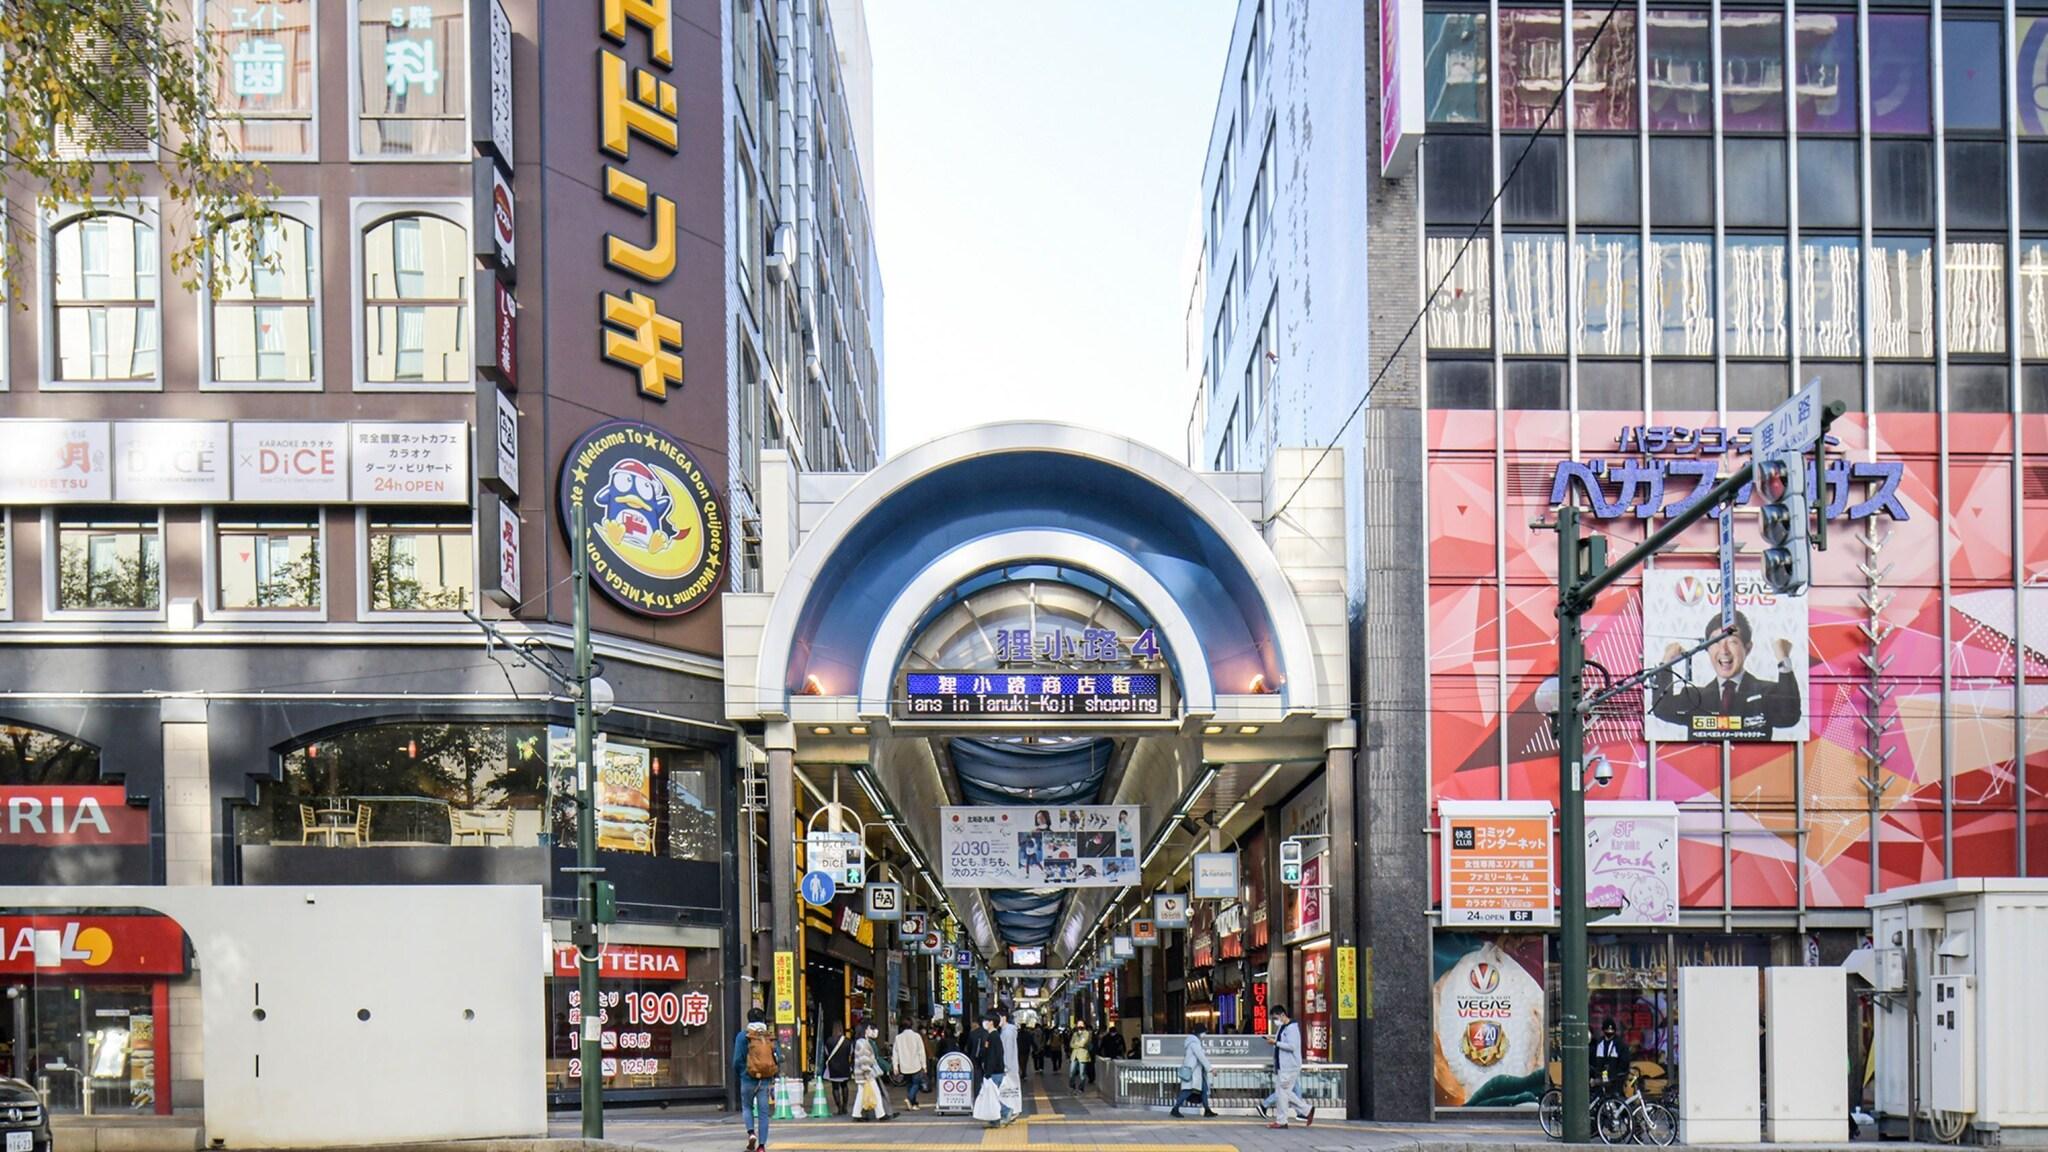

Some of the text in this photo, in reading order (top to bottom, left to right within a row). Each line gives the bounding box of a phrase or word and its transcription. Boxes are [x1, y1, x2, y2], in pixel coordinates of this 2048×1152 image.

[231, 7, 285, 30] エイト
[390, 7, 433, 29] 5階
[232, 39, 285, 95] 歯
[385, 39, 438, 95] 科
[302, 440, 333, 448] カラオケ
[579, 429, 643, 469] Welcome To
[128, 450, 215, 473] DCE
[260, 449, 335, 474] DiCE
[389, 449, 431, 459] カラオケ
[366, 463, 453, 473] ダーツ・ビリヤード
[374, 477, 445, 492] 24h OPEN
[1550, 460, 1911, 522] ベガスス
[659, 439, 723, 551] MEGA Don Quijote
[587, 542, 641, 602] MEGA Don
[657, 568, 717, 609] Welcome To
[1707, 582, 1773, 595] VGAS
[1707, 595, 1776, 606] VGAS
[996, 628, 1160, 662] 狸小路 4
[937, 675, 1132, 695] 狸小路商店街
[951, 695, 970, 712] in
[976, 695, 1074, 714] Tanuki-Koji
[1085, 695, 1158, 713] shopping
[0, 796, 111, 834] RIA
[1476, 827, 1516, 839] コミック
[1612, 820, 1635, 838] 5F
[951, 840, 990, 856] 2030
[1476, 838, 1546, 849] インターネット
[1469, 873, 1529, 881] ファミリールーム
[1467, 886, 1532, 894] ダーツ・ビリヤード
[1514, 911, 1529, 920] 6F
[560, 951, 680, 972] LTTERIA
[1588, 943, 1630, 968] PORO
[569, 991, 709, 1026] ゆり 190席
[1458, 1000, 1511, 1010] VEGAS
[1458, 1010, 1511, 1018] VEGAS
[569, 1009, 608, 1024] 座る
[569, 1032, 651, 1050] 1 65席
[1202, 1039, 1249, 1047] LE TOWN
[569, 1058, 658, 1077] 2 125席
